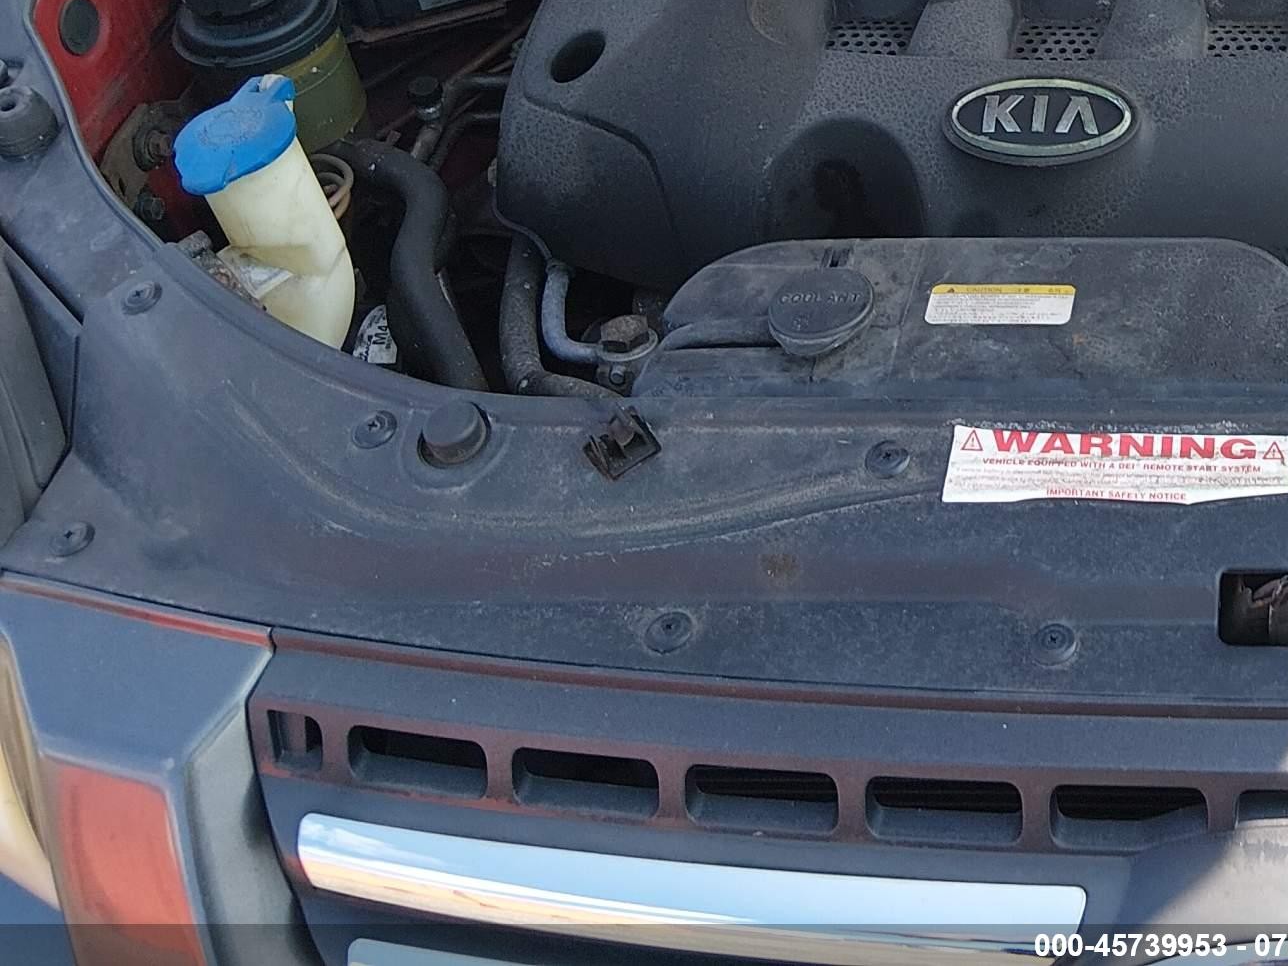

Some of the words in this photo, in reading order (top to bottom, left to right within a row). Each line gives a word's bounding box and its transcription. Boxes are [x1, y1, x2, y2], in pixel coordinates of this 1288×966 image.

[982, 94, 1099, 135] KIA
[779, 290, 861, 303] COOLANT
[992, 428, 1257, 460] WARNING
[983, 457, 1025, 466] VEHICLE
[1080, 460, 1105, 469] WITH
[1143, 463, 1184, 472] REMOTE
[1186, 464, 1217, 472] START
[1221, 464, 1262, 474] SYSTEM
[1046, 488, 1105, 498] IMPORTANT
[1108, 491, 1146, 499] SAFETY
[1149, 491, 1187, 500] NOTICE
